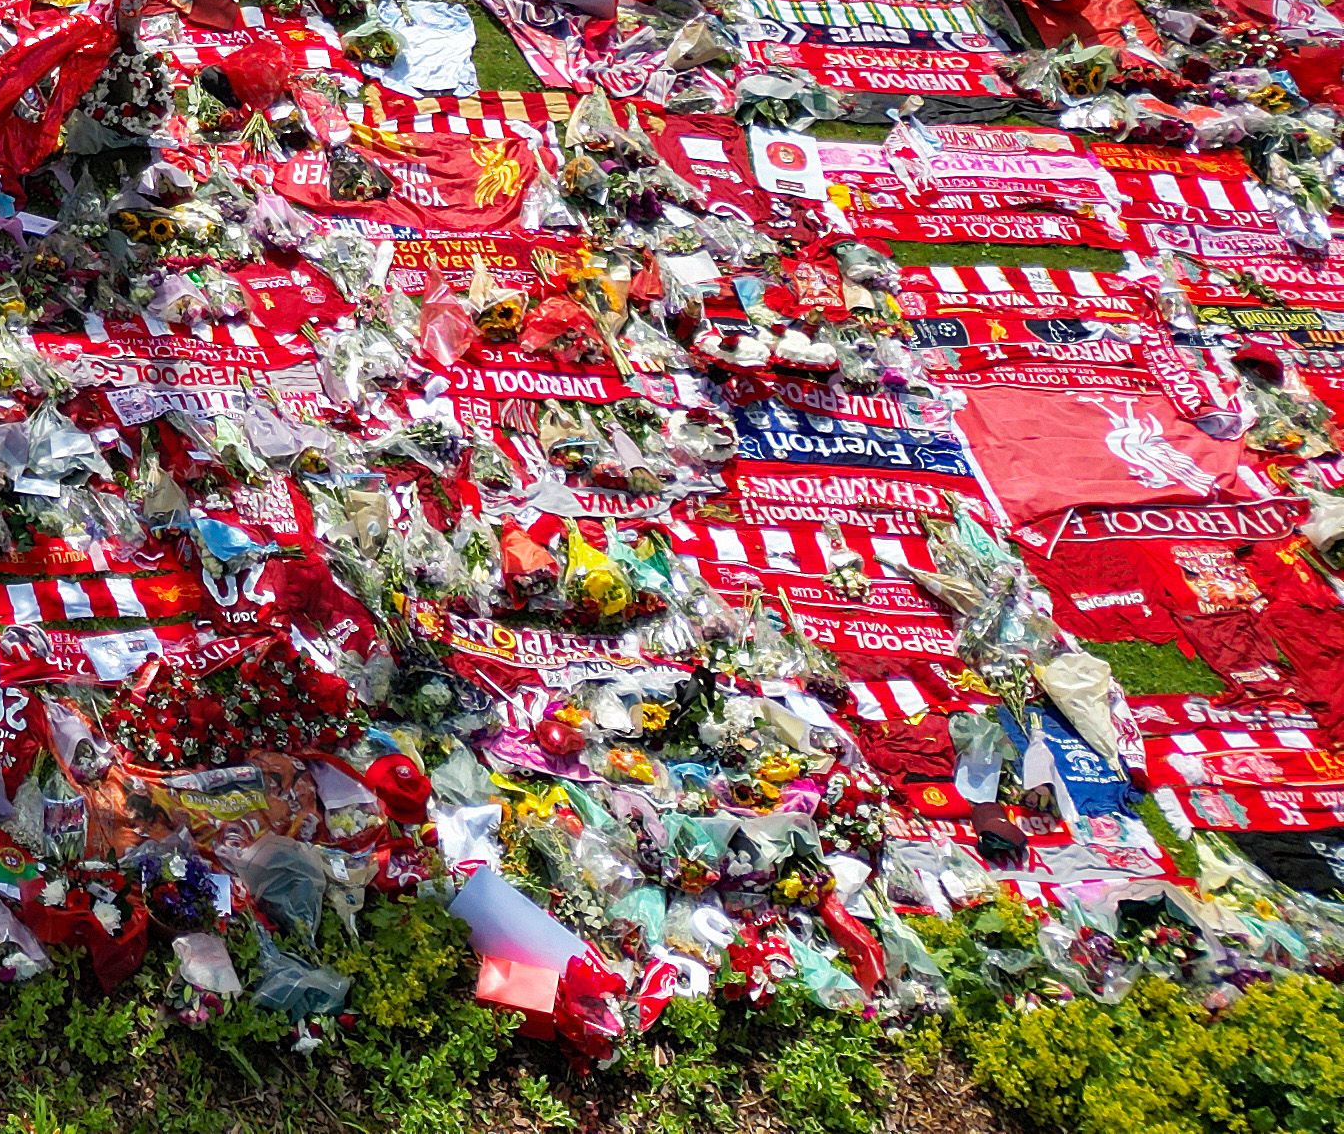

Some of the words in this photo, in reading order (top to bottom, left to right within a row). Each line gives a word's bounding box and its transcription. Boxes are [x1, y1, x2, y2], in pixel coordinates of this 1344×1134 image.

[824, 52, 971, 71] CHAMPIONS
[826, 70, 855, 88] FC
[859, 70, 972, 92] LIVERPOOL
[936, 129, 980, 147] NEVER
[982, 132, 1019, 149] YOU'LL
[934, 155, 1041, 173] LIVERPO
[1146, 201, 1209, 225] 12th
[918, 221, 951, 238] FC
[436, 239, 498, 254] FINAL
[1204, 284, 1237, 298] FC
[937, 292, 968, 309] ON
[973, 292, 1031, 309] WALK
[1039, 293, 1078, 310] ON
[1081, 294, 1135, 311] WALK
[1234, 311, 1323, 326] DORTMUND
[480, 349, 504, 363] FC
[91, 360, 123, 382] FC
[124, 364, 270, 385] LIVERPOOL
[447, 366, 484, 393] F.C.
[984, 370, 1070, 385] FOOTBALL
[484, 369, 605, 399] LIVERPOOL
[765, 431, 906, 464] Everton
[752, 476, 939, 506] CHAMPIONS
[754, 504, 889, 533] Liverpool
[1096, 506, 1287, 534] LIVERPOOL
[1075, 590, 1145, 609] CHAMPIONS
[844, 619, 888, 633] WALK
[891, 621, 943, 639] NEVER
[856, 627, 954, 654] ERPOOL
[1279, 801, 1309, 826] FC
